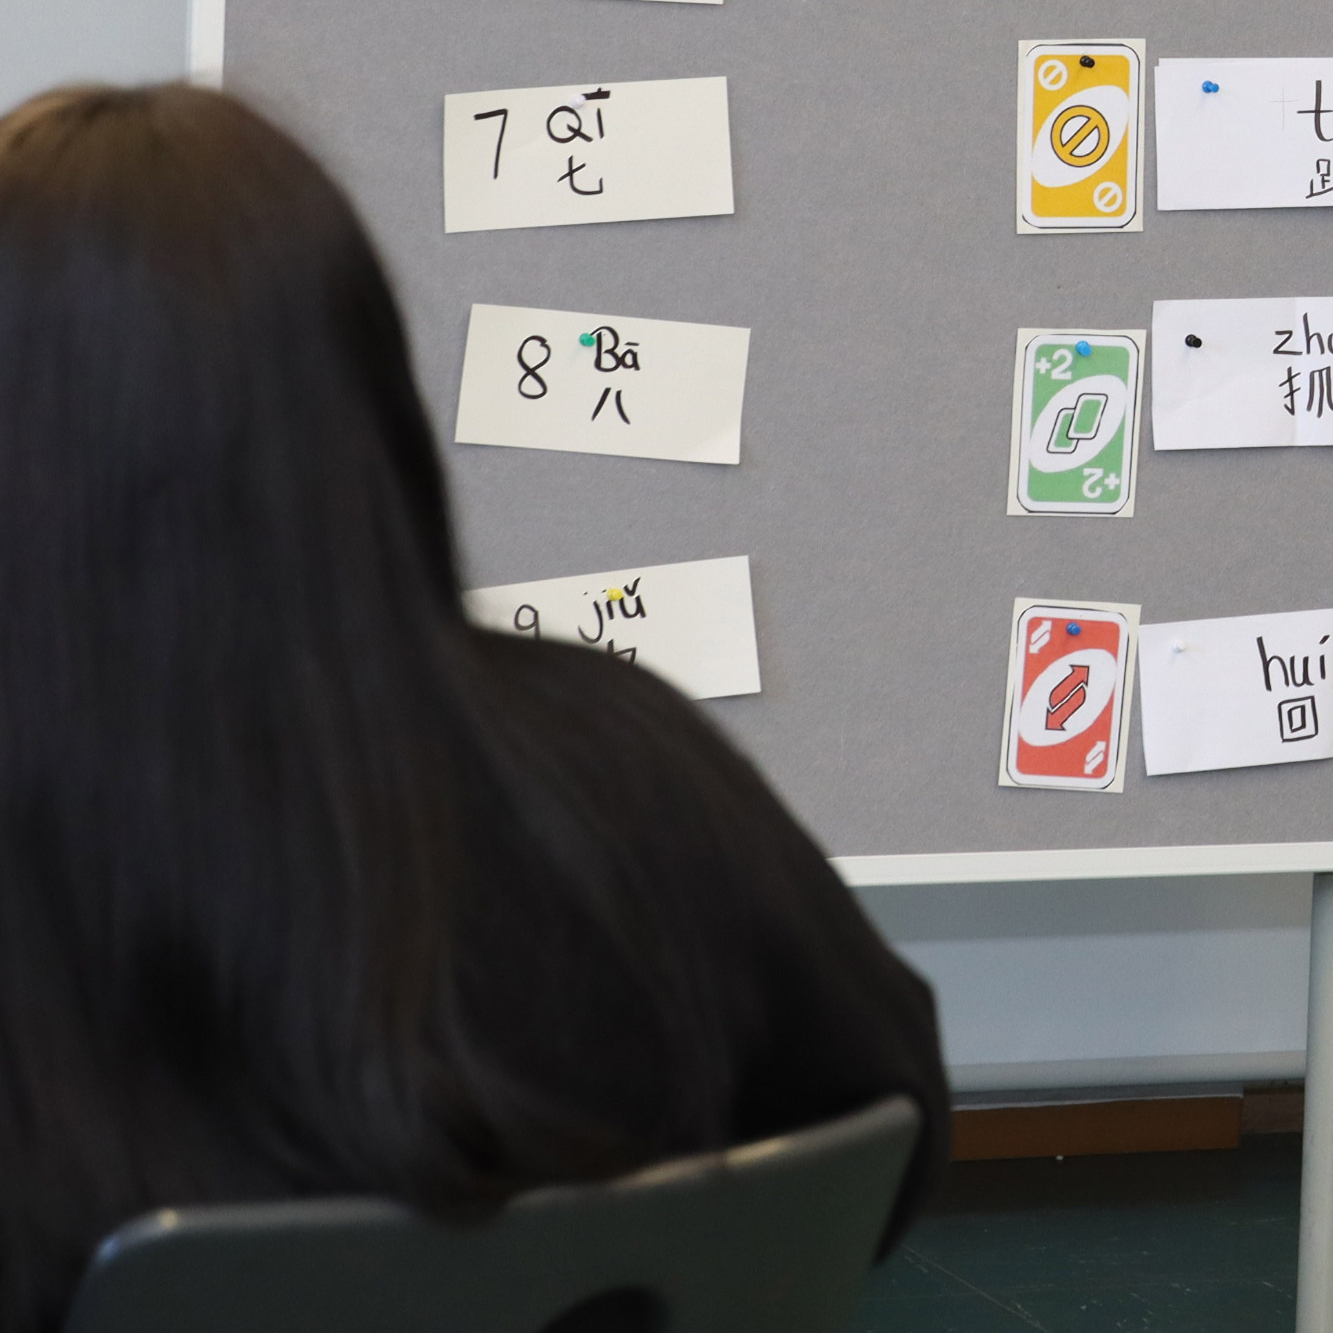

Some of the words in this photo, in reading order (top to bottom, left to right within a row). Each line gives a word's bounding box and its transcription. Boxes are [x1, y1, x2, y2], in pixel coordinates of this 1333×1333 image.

[473, 108, 509, 180] 7
[557, 155, 604, 196] 七
[516, 334, 552, 400] 8
[589, 325, 641, 373] Bā
[1036, 349, 1074, 380] +2
[591, 387, 631, 425] 八
[575, 577, 647, 646] jiǔ
[1256, 634, 1330, 692] huí
[1277, 695, 1319, 744] 回
